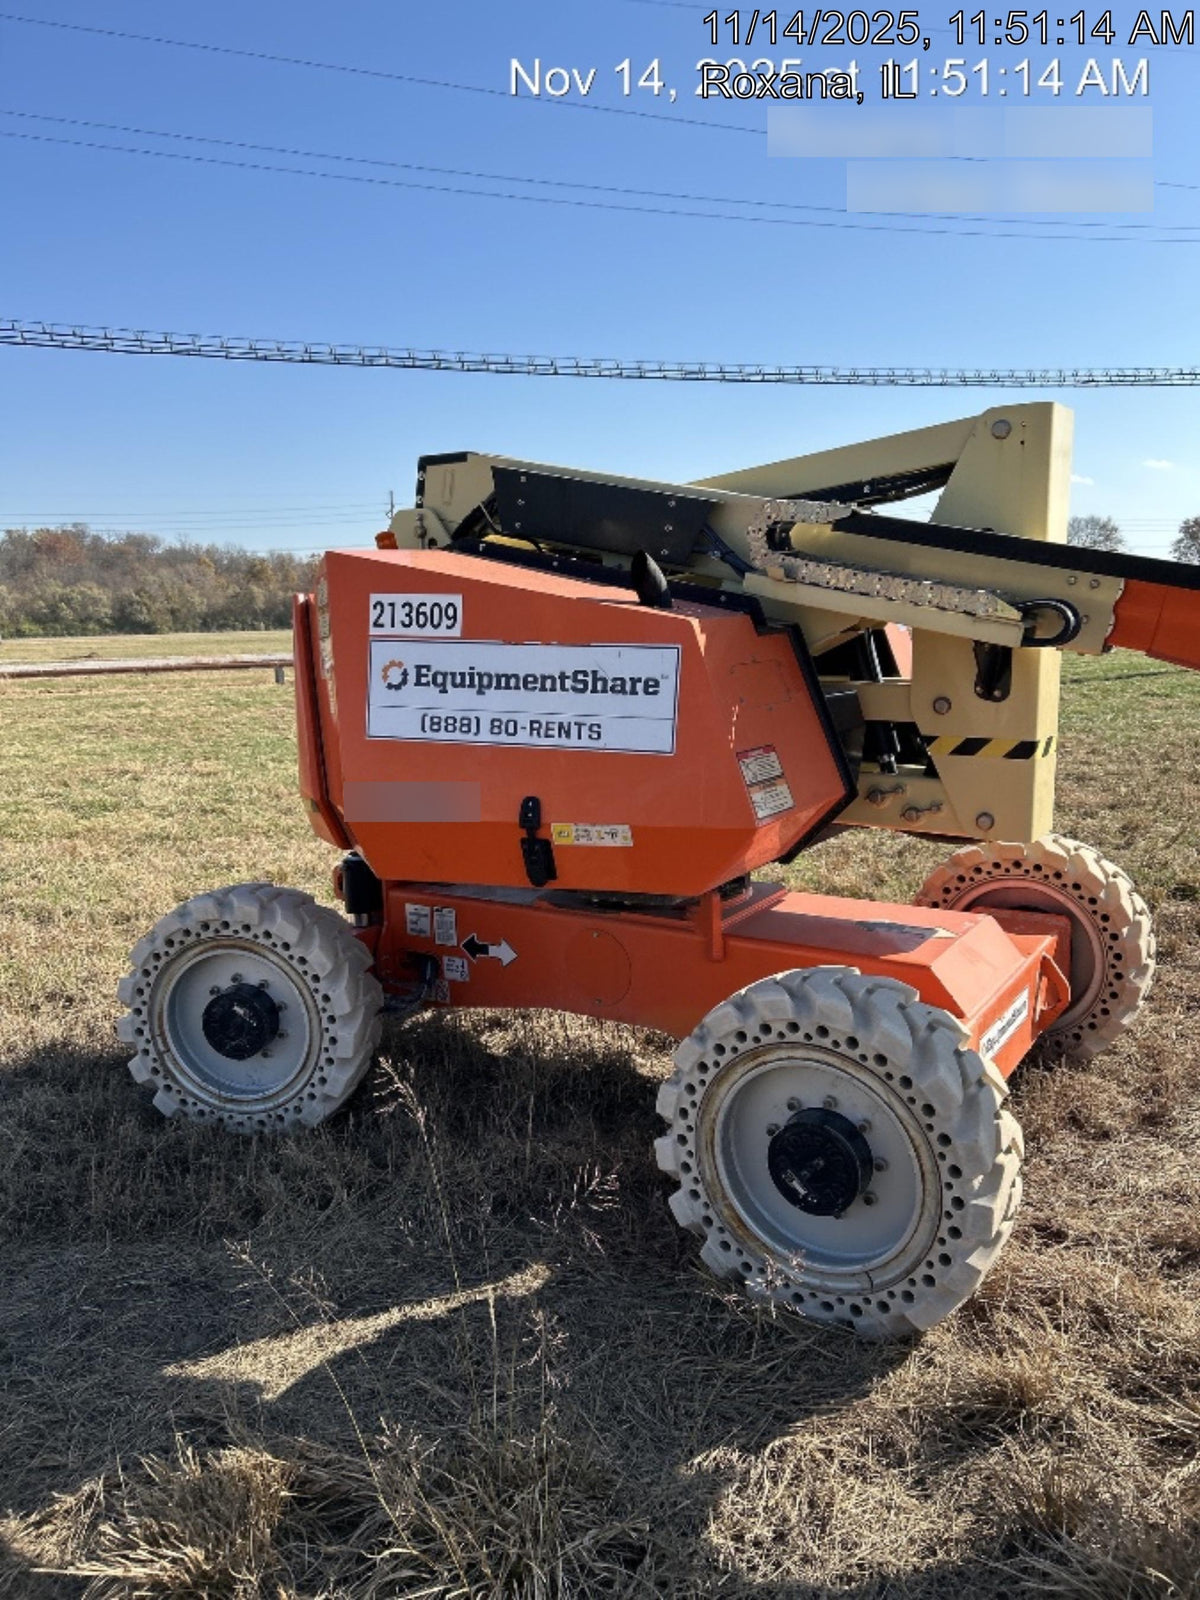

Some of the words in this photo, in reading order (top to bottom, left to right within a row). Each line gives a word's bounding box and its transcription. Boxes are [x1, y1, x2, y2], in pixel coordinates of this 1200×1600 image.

[372, 600, 458, 630] 213609
[413, 664, 661, 696] EquipmentShare
[420, 713, 481, 736] (888)
[489, 717, 602, 741] 80-RENTS
